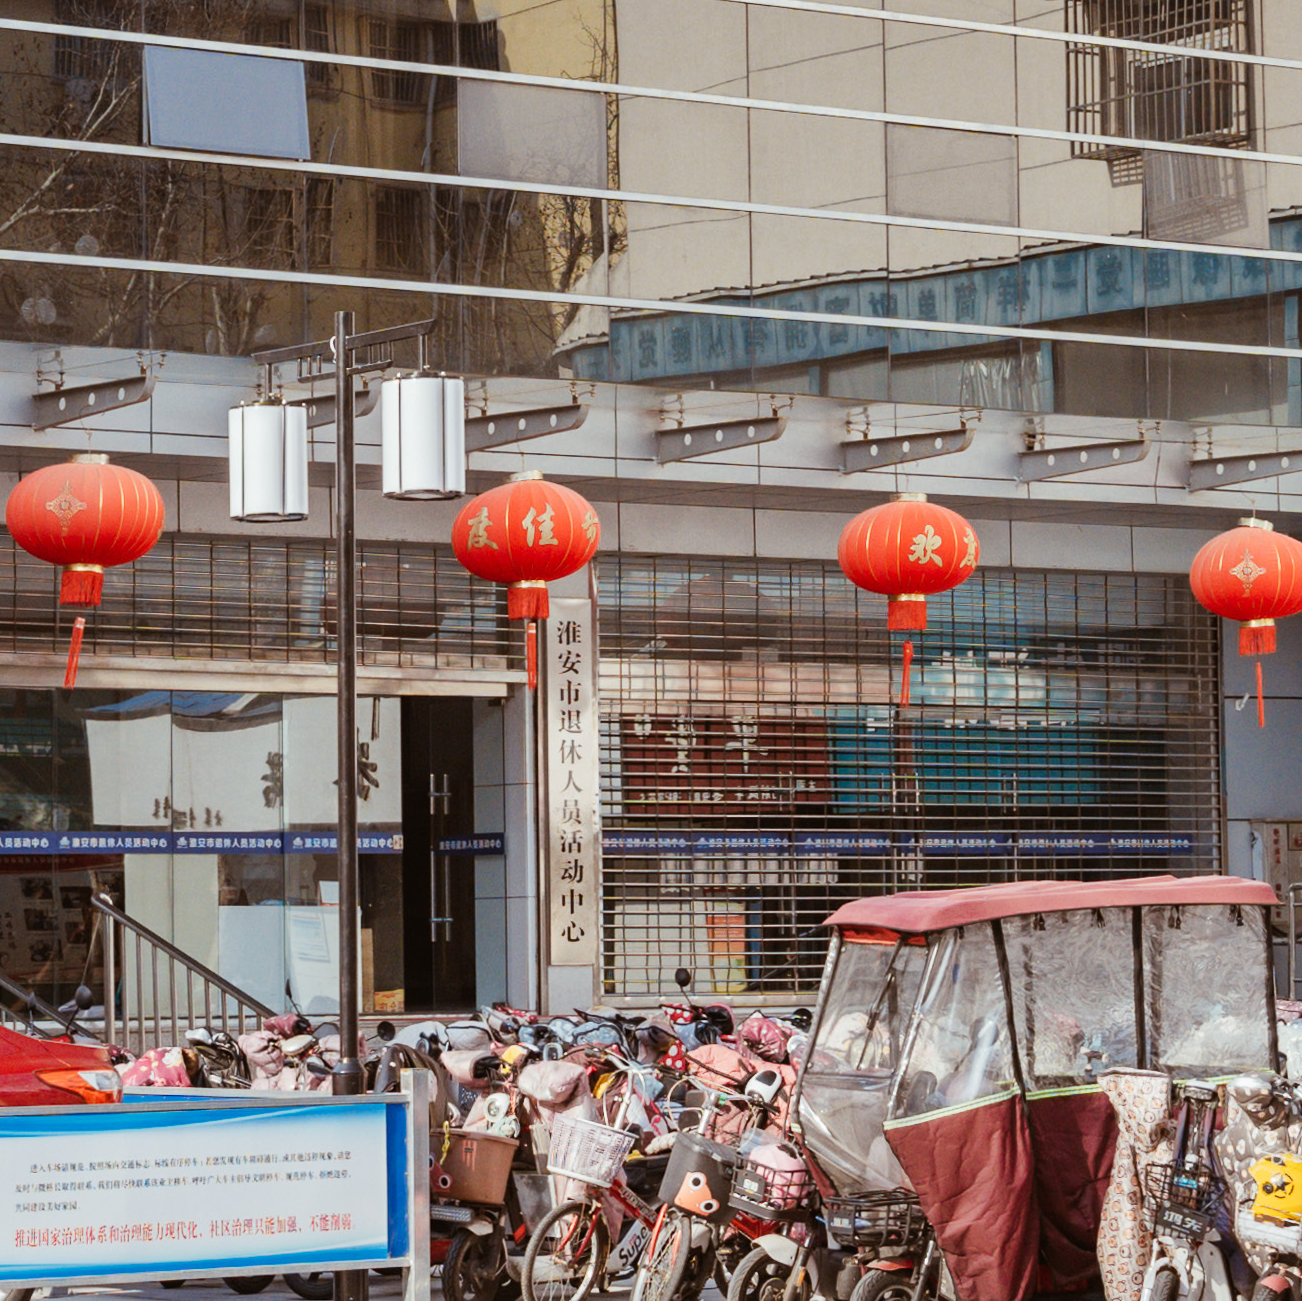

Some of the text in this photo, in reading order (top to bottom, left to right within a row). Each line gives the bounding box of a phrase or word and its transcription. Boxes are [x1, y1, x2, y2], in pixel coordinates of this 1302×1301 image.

[557, 620, 585, 943] 淮安市退休人员活动中心
